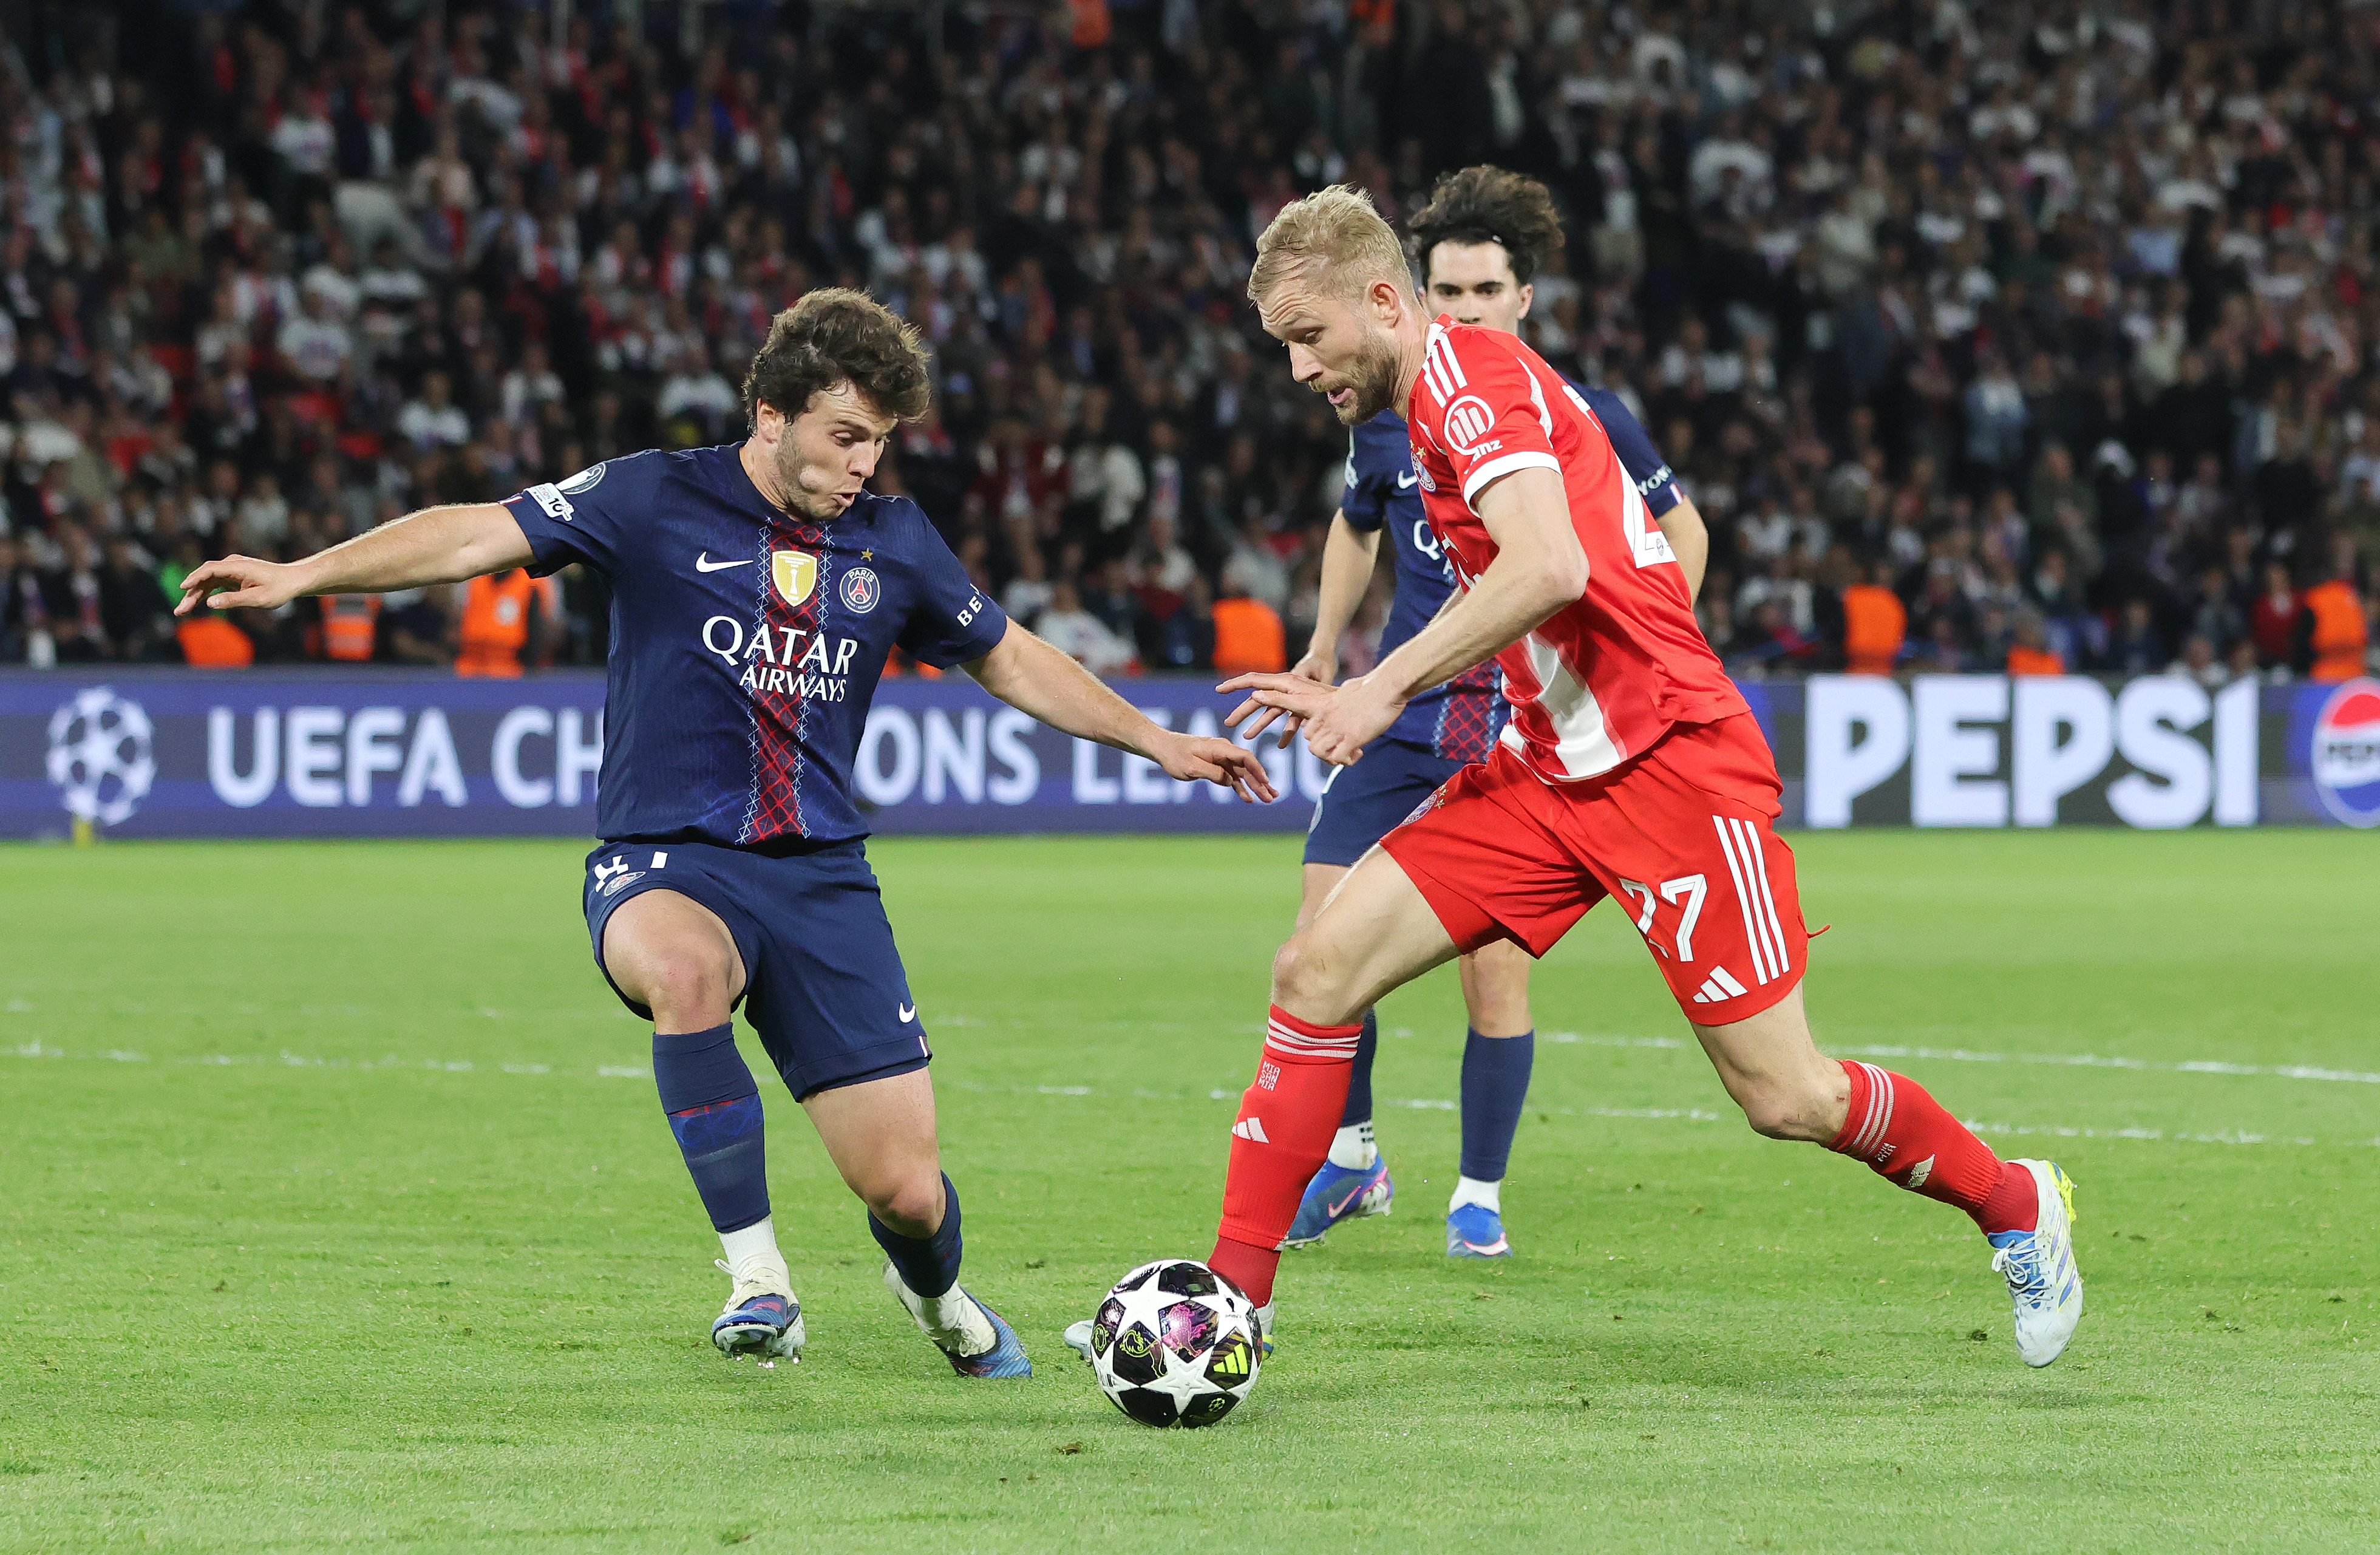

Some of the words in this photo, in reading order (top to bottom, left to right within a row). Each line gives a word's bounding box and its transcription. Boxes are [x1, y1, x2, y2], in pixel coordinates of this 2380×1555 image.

[848, 570, 875, 582] PARIS
[702, 616, 858, 675] QATAR
[739, 665, 847, 703] AIRWAYS
[206, 704, 468, 809] UEFA
[491, 704, 1041, 809] CHONS
[1805, 673, 2259, 829] PEPSI
[1619, 873, 1708, 962] 27
[1257, 1077, 1275, 1091] MIA
[1260, 1069, 1278, 1084] SAN
[1262, 1060, 1280, 1075] MIA
